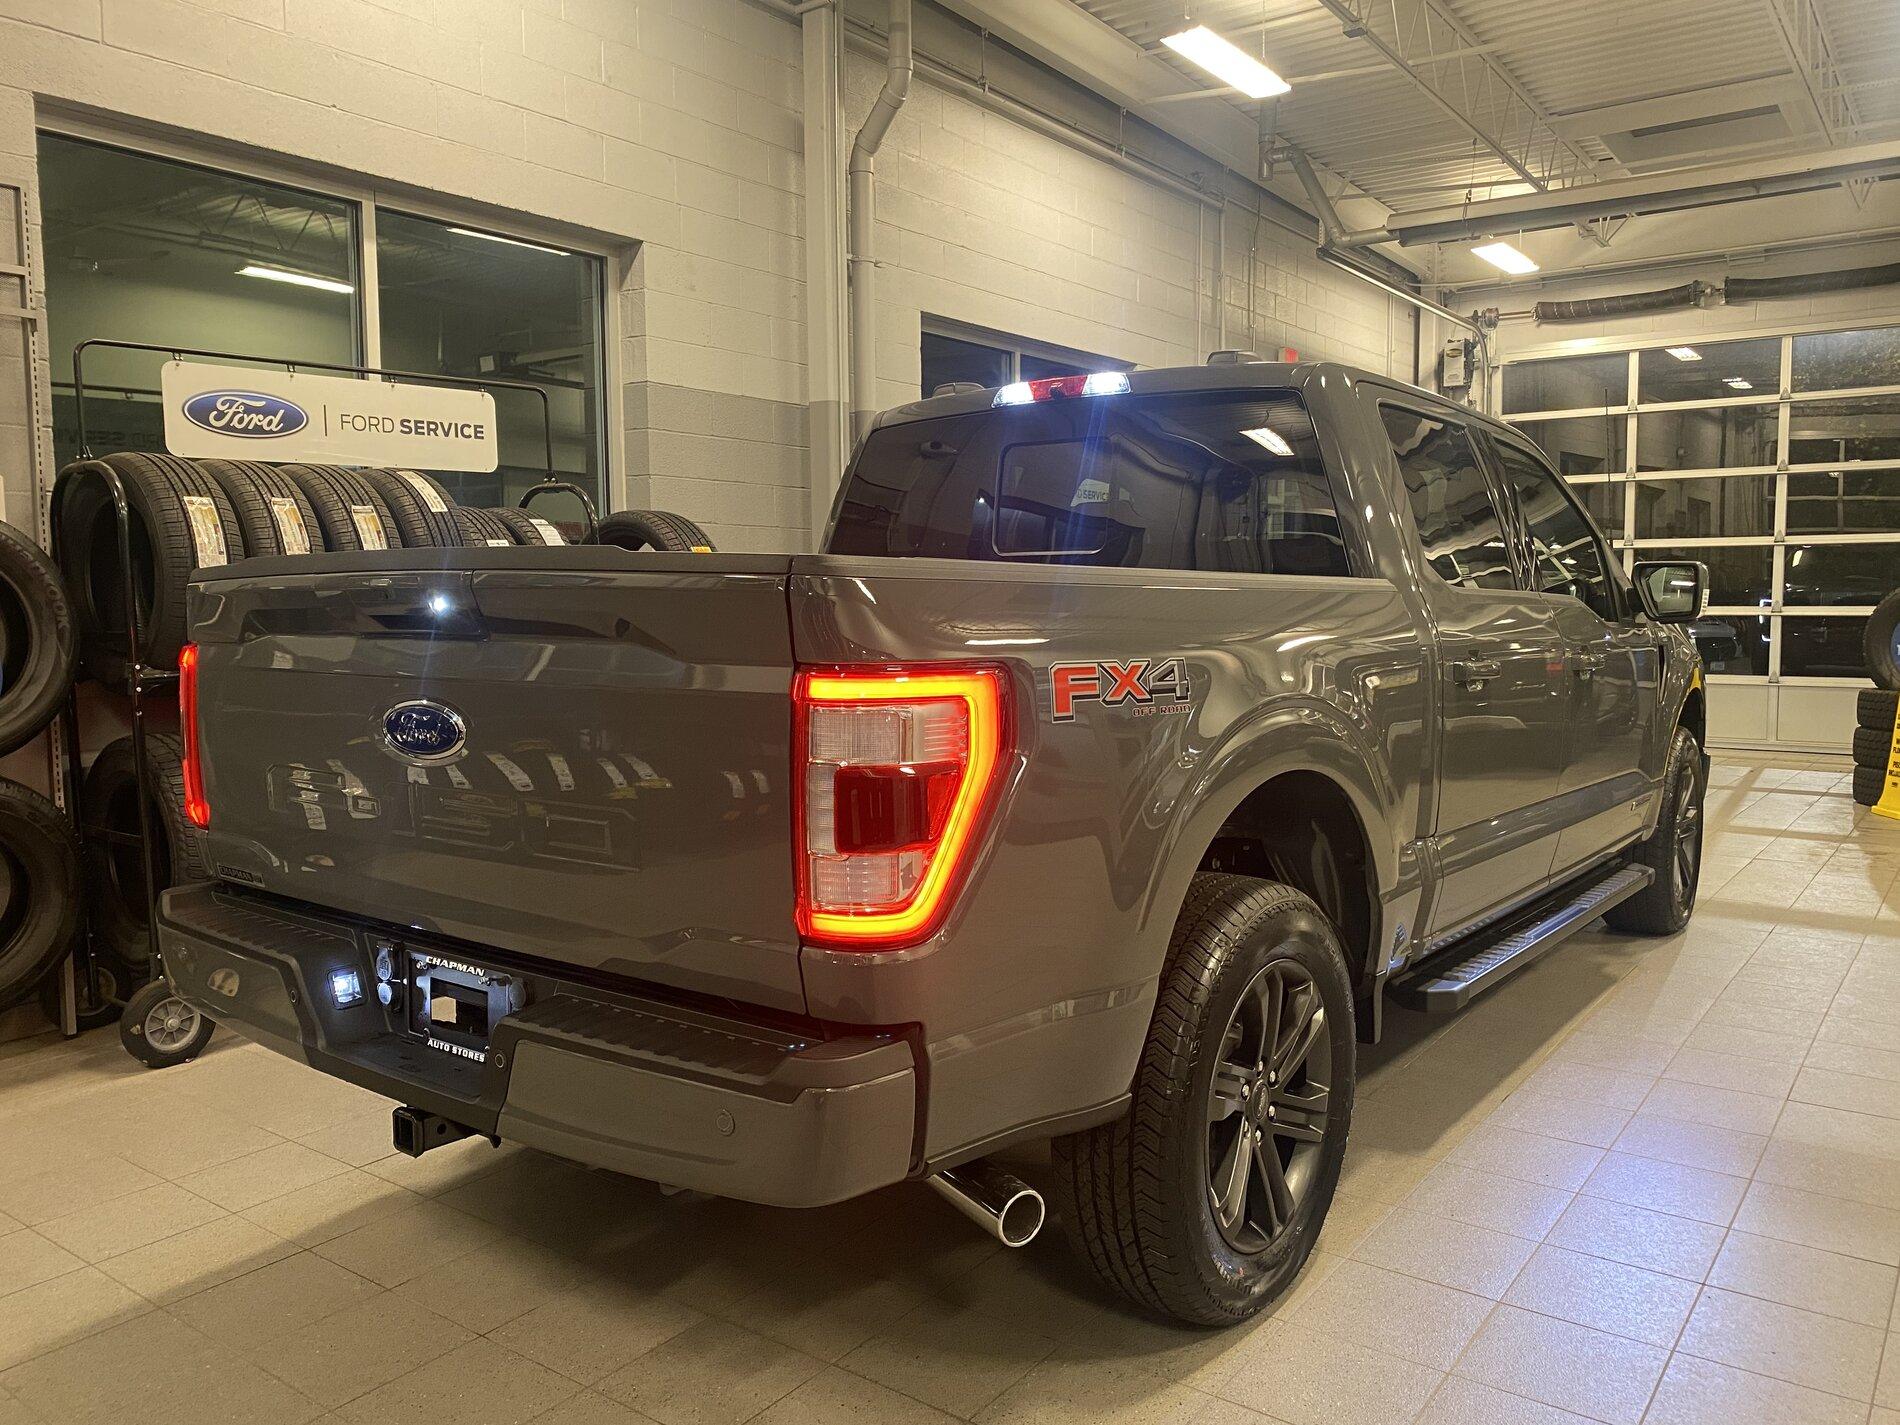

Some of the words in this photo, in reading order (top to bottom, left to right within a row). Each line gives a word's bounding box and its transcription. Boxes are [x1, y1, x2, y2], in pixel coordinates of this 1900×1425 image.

[208, 396, 285, 433] Ford
[340, 413, 395, 433] FORD
[400, 418, 485, 440] SERVICE
[1048, 657, 1191, 724] FX4
[1132, 706, 1157, 717] OFF
[1160, 704, 1191, 715] ROAD
[396, 712, 441, 746] Ford
[425, 955, 485, 977] CHAPMAN
[427, 1039, 450, 1052] AUTO
[452, 1045, 485, 1063] STORES
